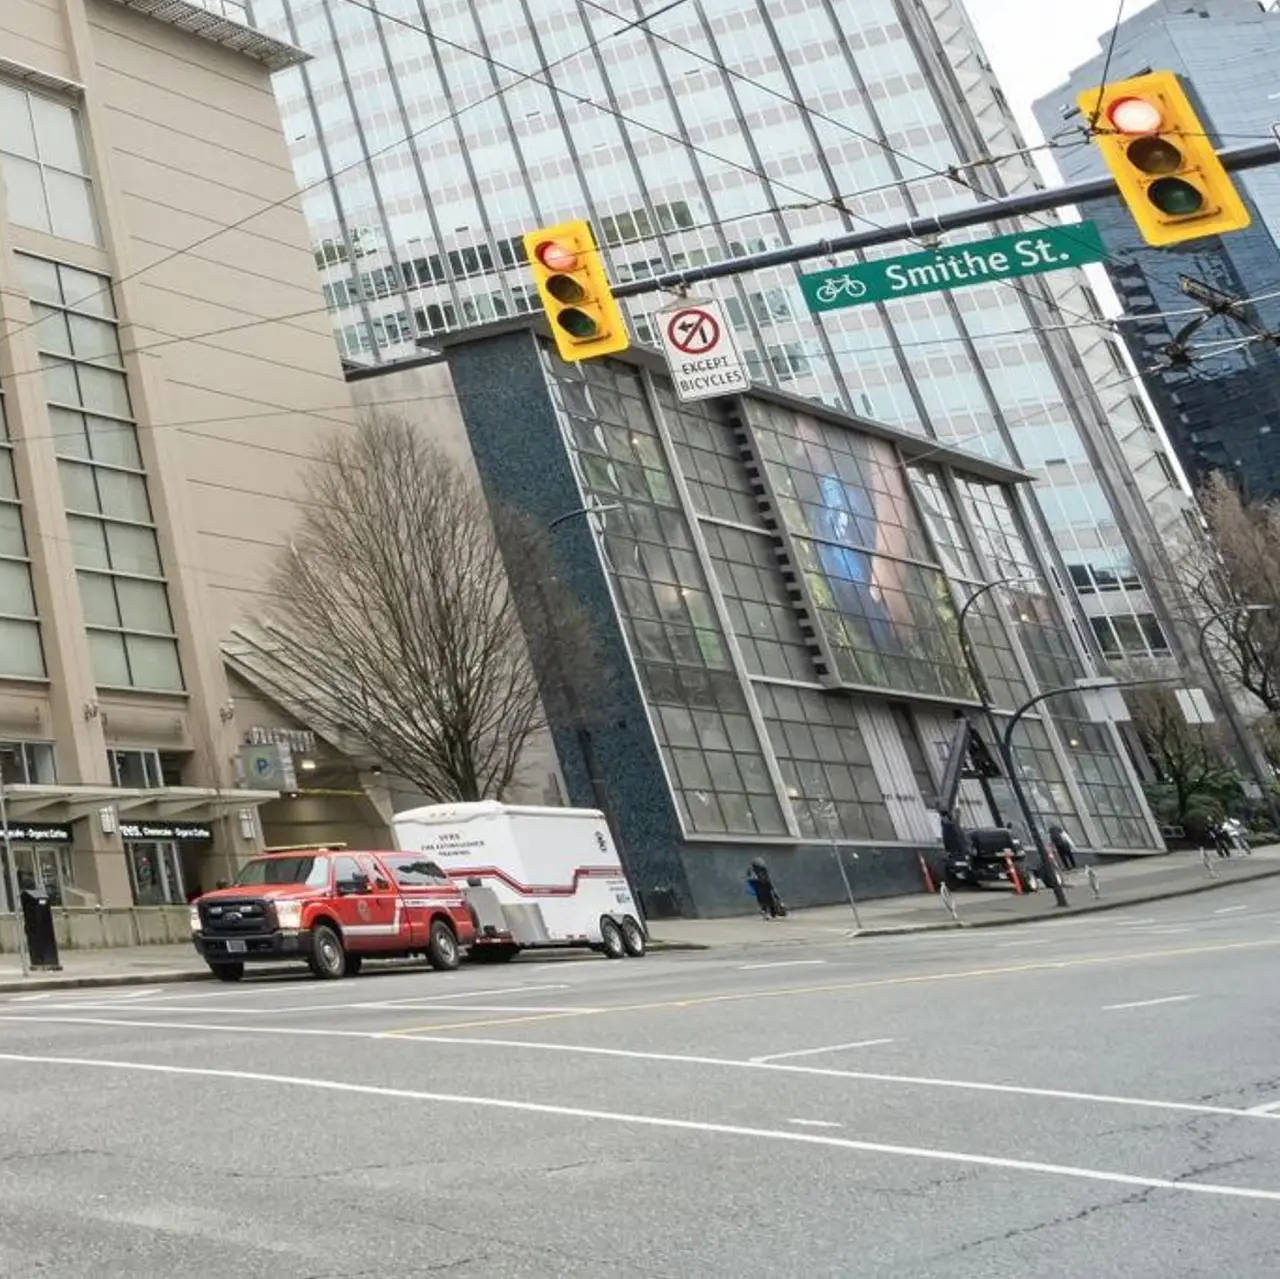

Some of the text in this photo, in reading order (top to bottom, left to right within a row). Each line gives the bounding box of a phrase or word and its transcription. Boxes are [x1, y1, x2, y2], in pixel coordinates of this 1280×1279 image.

[886, 238, 1070, 291] Smithe St.
[682, 355, 728, 375] EXCEPT
[680, 370, 741, 392] BICYCLES
